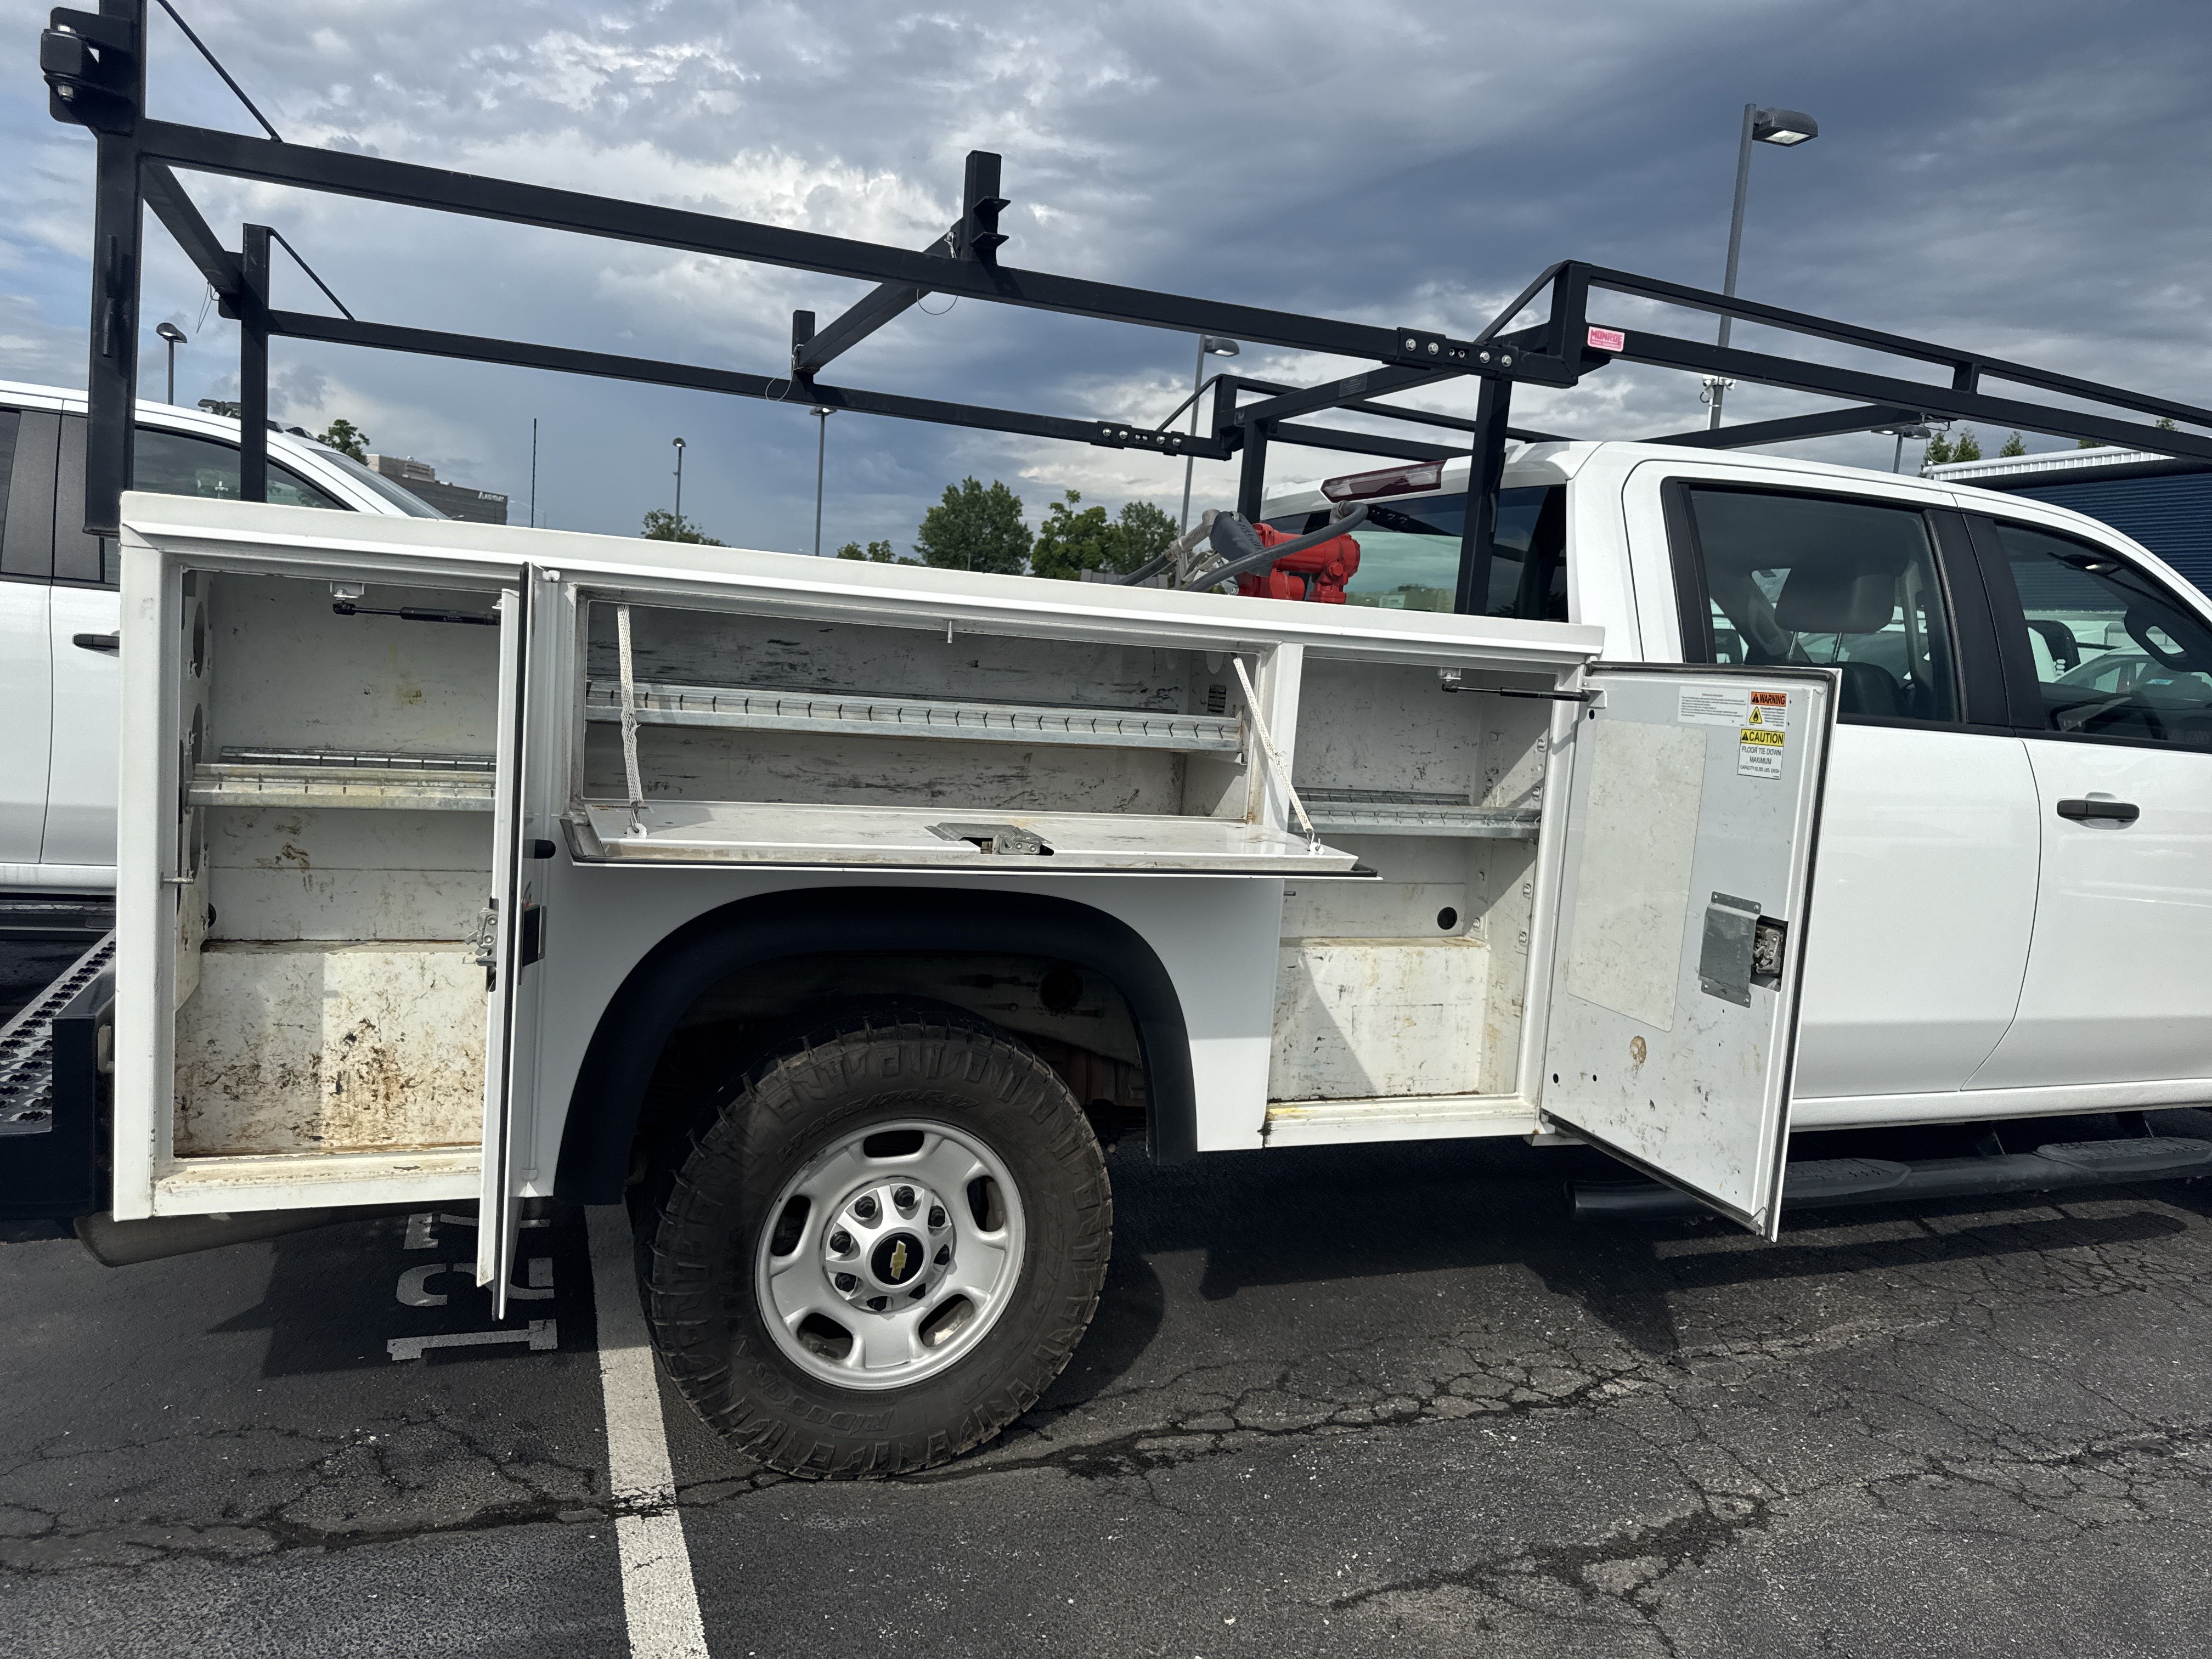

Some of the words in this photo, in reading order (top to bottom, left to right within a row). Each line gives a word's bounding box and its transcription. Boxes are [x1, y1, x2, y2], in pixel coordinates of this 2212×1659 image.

[1591, 330, 1623, 342] MONROE
[1759, 693, 1785, 706] WARNING
[1749, 731, 1784, 744] CAUTION
[1750, 756, 1772, 765] MAXIMUM
